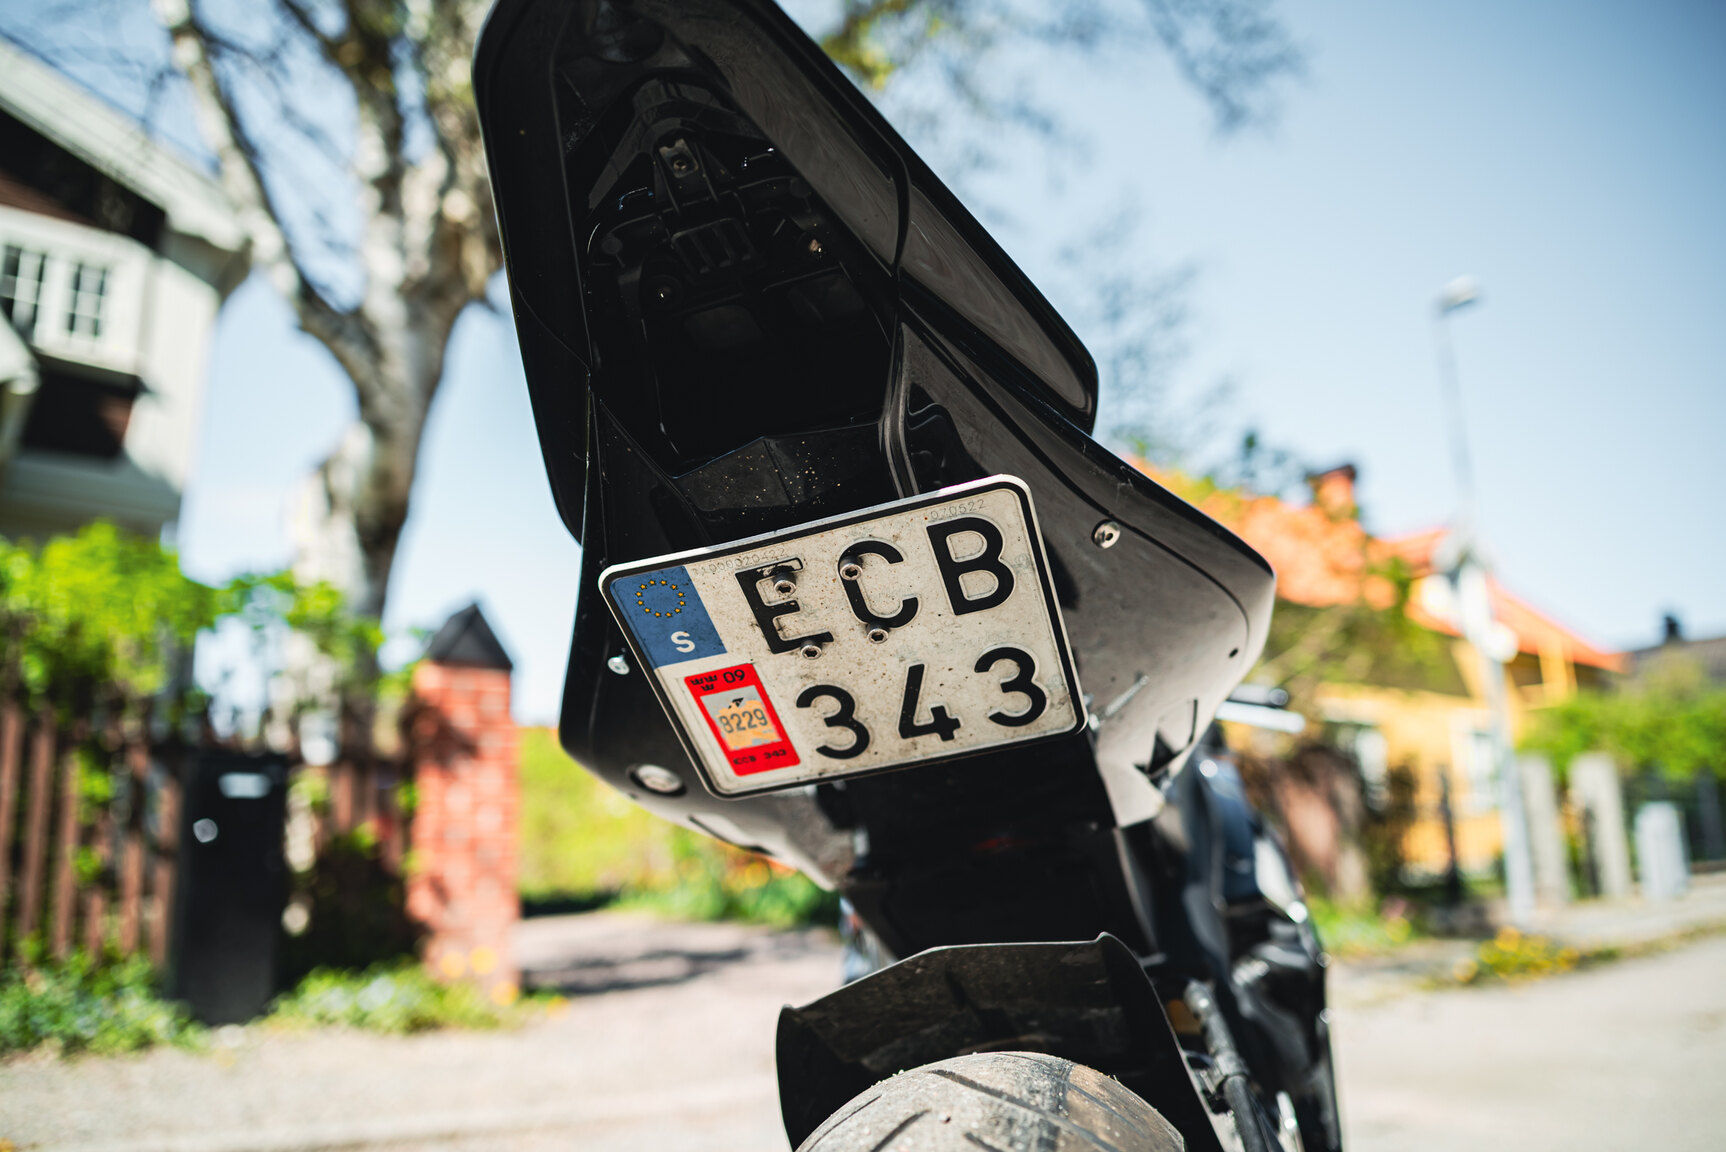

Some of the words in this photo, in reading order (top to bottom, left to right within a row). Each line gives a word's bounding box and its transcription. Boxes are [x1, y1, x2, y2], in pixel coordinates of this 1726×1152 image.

[735, 516, 1016, 655] ECB
[670, 631, 696, 653] S
[723, 669, 745, 684] 09
[796, 646, 1048, 760] 343
